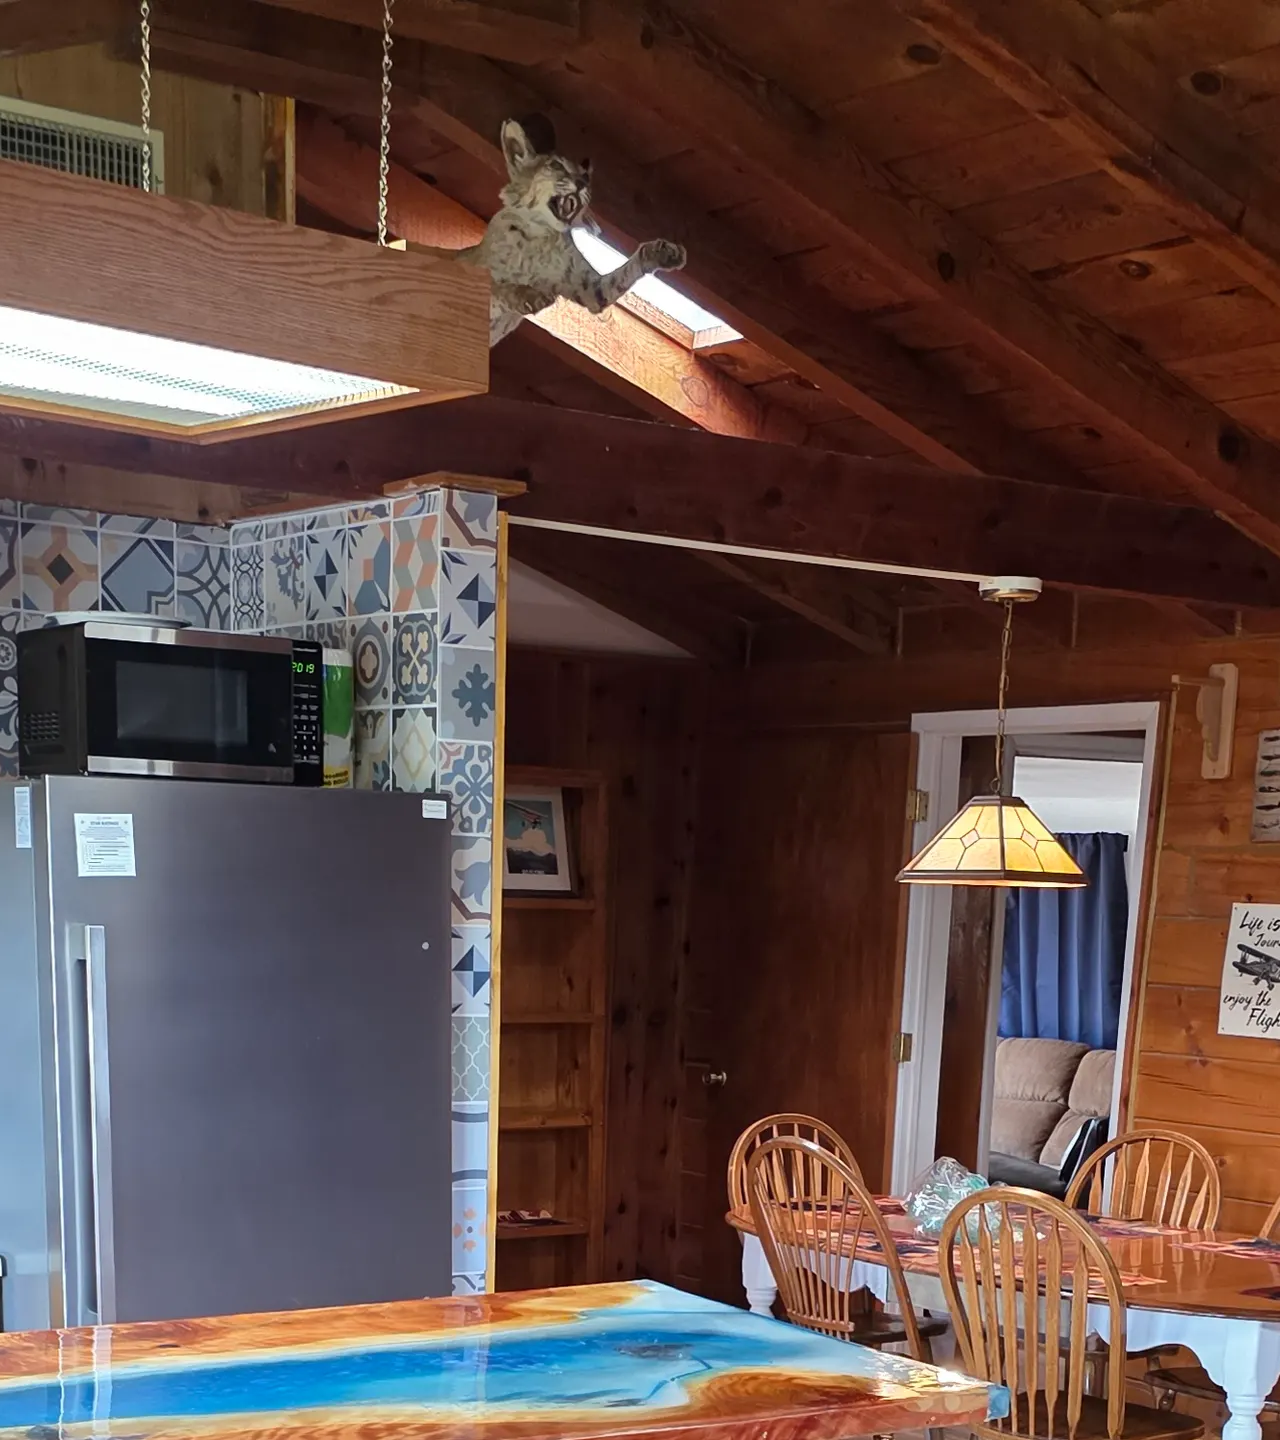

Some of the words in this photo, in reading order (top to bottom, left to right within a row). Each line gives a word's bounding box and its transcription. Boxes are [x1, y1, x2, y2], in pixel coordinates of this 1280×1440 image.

[1239, 911, 1263, 936] Life
[1267, 918, 1280, 931] is
[1223, 993, 1253, 1011] enjoy
[1255, 990, 1272, 1007] the
